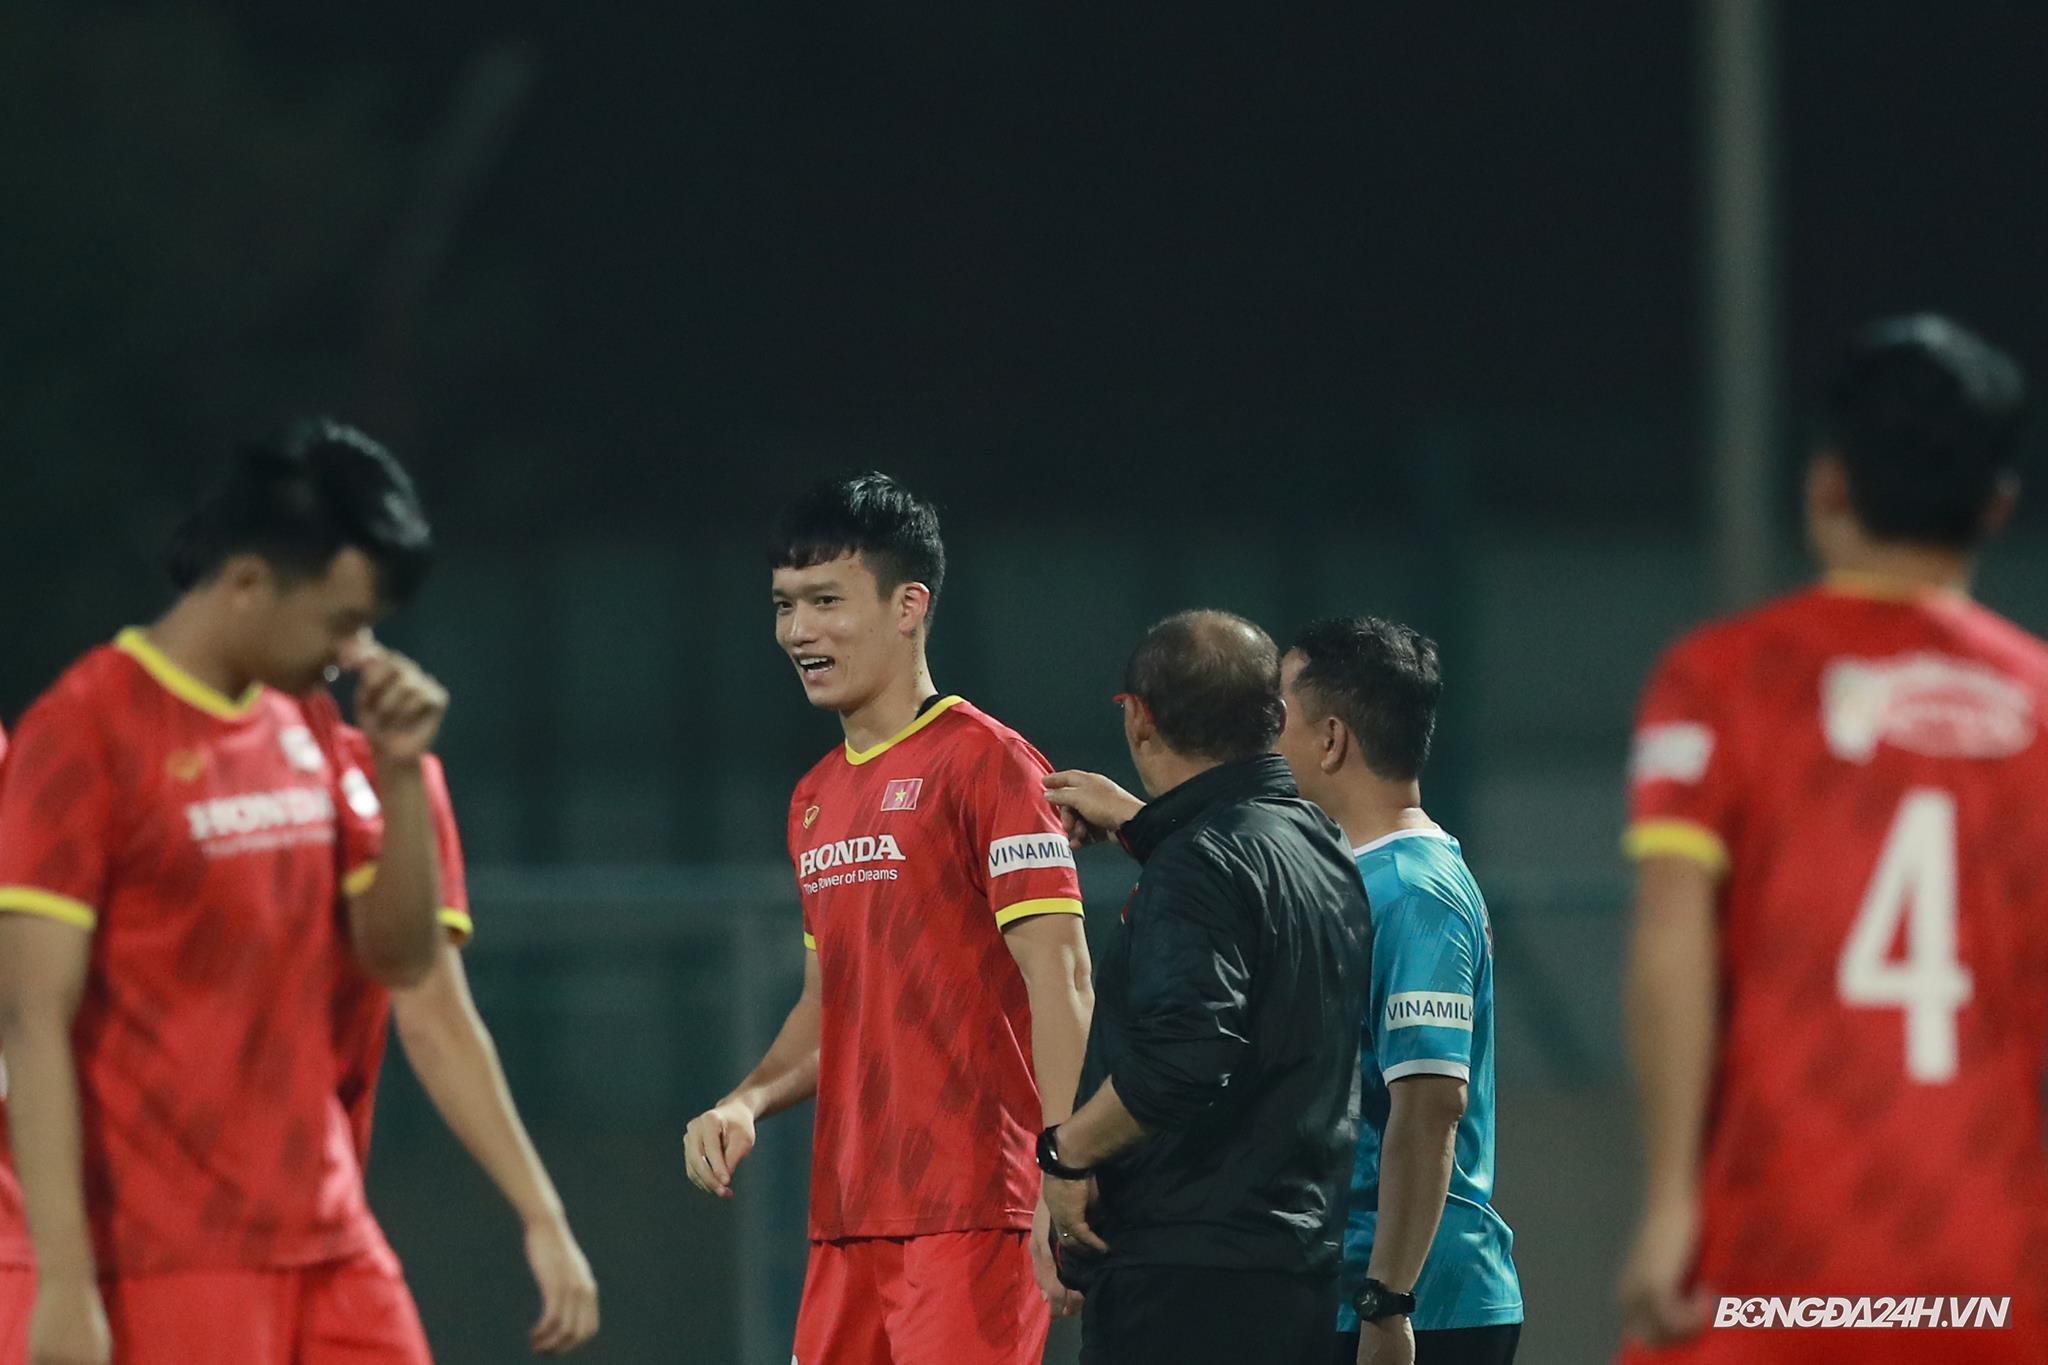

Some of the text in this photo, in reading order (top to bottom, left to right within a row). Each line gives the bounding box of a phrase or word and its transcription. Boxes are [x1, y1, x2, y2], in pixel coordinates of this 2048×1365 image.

[800, 834, 906, 878] HONDA
[989, 841, 1071, 867] VINAMIL
[803, 883, 818, 895] The
[845, 870, 856, 884] of
[858, 868, 898, 882] Dreams
[1839, 790, 1973, 1082] 4
